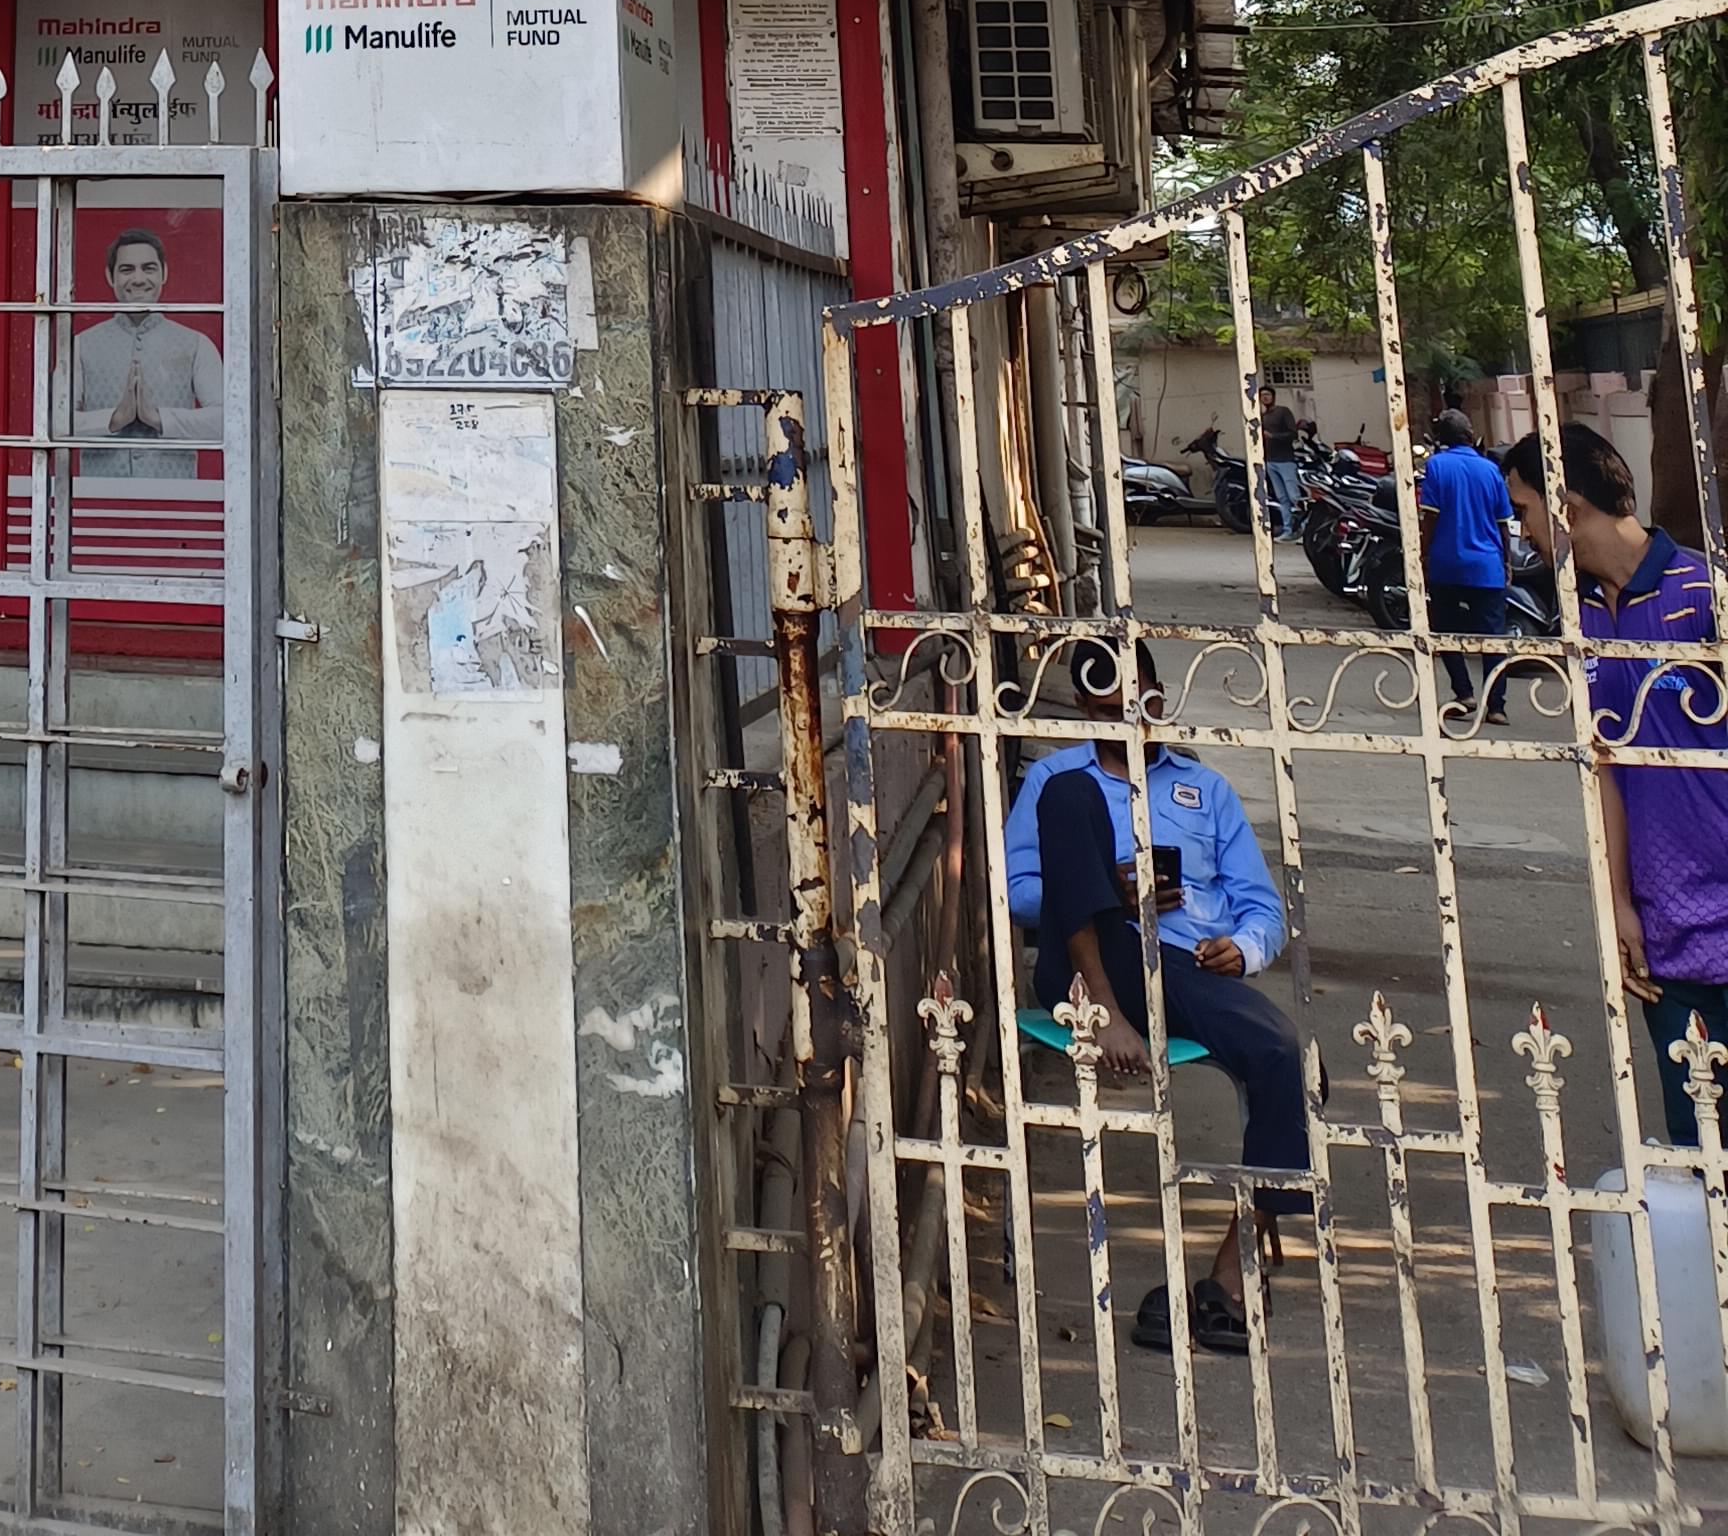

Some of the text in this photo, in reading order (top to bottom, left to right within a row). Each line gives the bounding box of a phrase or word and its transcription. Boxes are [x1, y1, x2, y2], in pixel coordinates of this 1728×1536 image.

[344, 8, 588, 51] Manulife MUTUAL
[507, 29, 561, 47] FUND
[65, 35, 240, 66] Manulife MUTUAL
[181, 50, 221, 64] FUND
